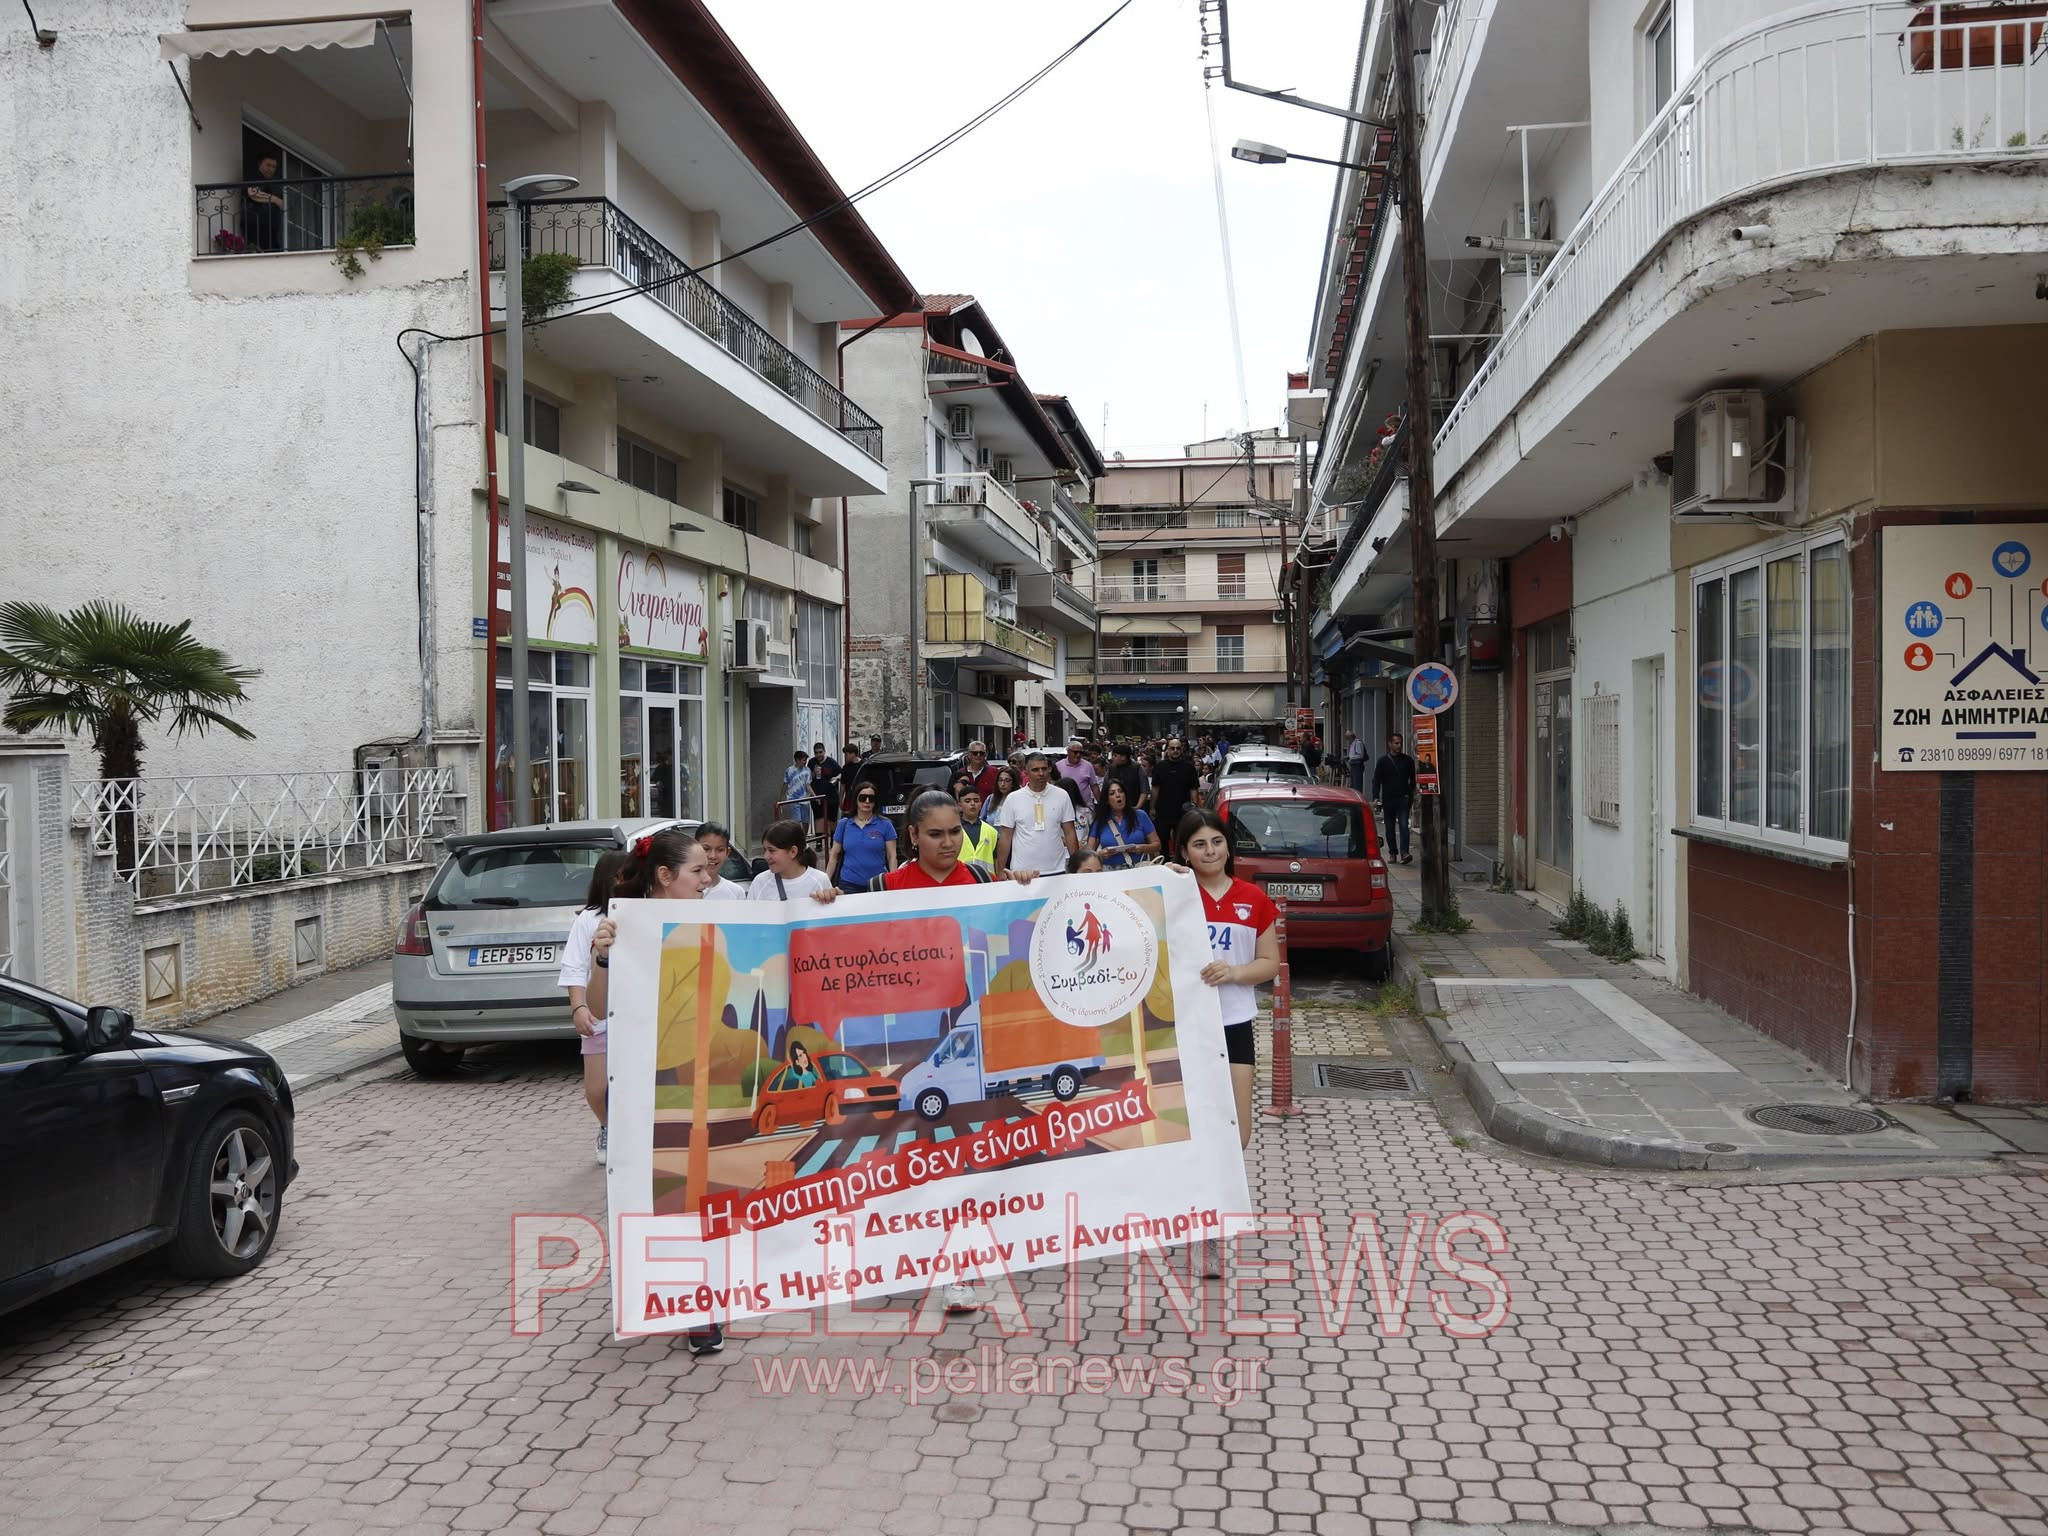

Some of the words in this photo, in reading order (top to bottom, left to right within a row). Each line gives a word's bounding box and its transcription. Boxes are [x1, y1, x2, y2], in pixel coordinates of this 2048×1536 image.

[1944, 688, 2045, 701] ΑΣΦΑΛΕΙΕΣ
[1893, 708, 1931, 725] ΖΩΗ
[1920, 748, 1954, 762] 23810
[1063, 889, 1096, 900] Ατόμων
[1098, 891, 1108, 900] με
[1110, 897, 1144, 929] Αναπηρία
[794, 953, 831, 974] Καλά
[834, 947, 898, 970] τυφλός
[821, 976, 841, 992] Δε
[1051, 967, 1138, 992] Συμβαδί-ζω
[1108, 995, 1127, 1011] 2022
[707, 1203, 732, 1234] Η
[745, 1159, 899, 1225] αναπηρία
[907, 1143, 961, 1179] δεν
[973, 1124, 1039, 1166] είναι
[1046, 1092, 1146, 1149] βρισιά
[813, 1219, 855, 1248] 3η
[864, 1190, 1045, 1238] Δεκεμβρίου
[643, 1278, 770, 1321] Διεθνής
[781, 1260, 884, 1301] Ημέρα
[894, 1236, 1013, 1281] Ατόμων
[1025, 1234, 1061, 1263] με
[1072, 1205, 1219, 1249] Αναπηρία
